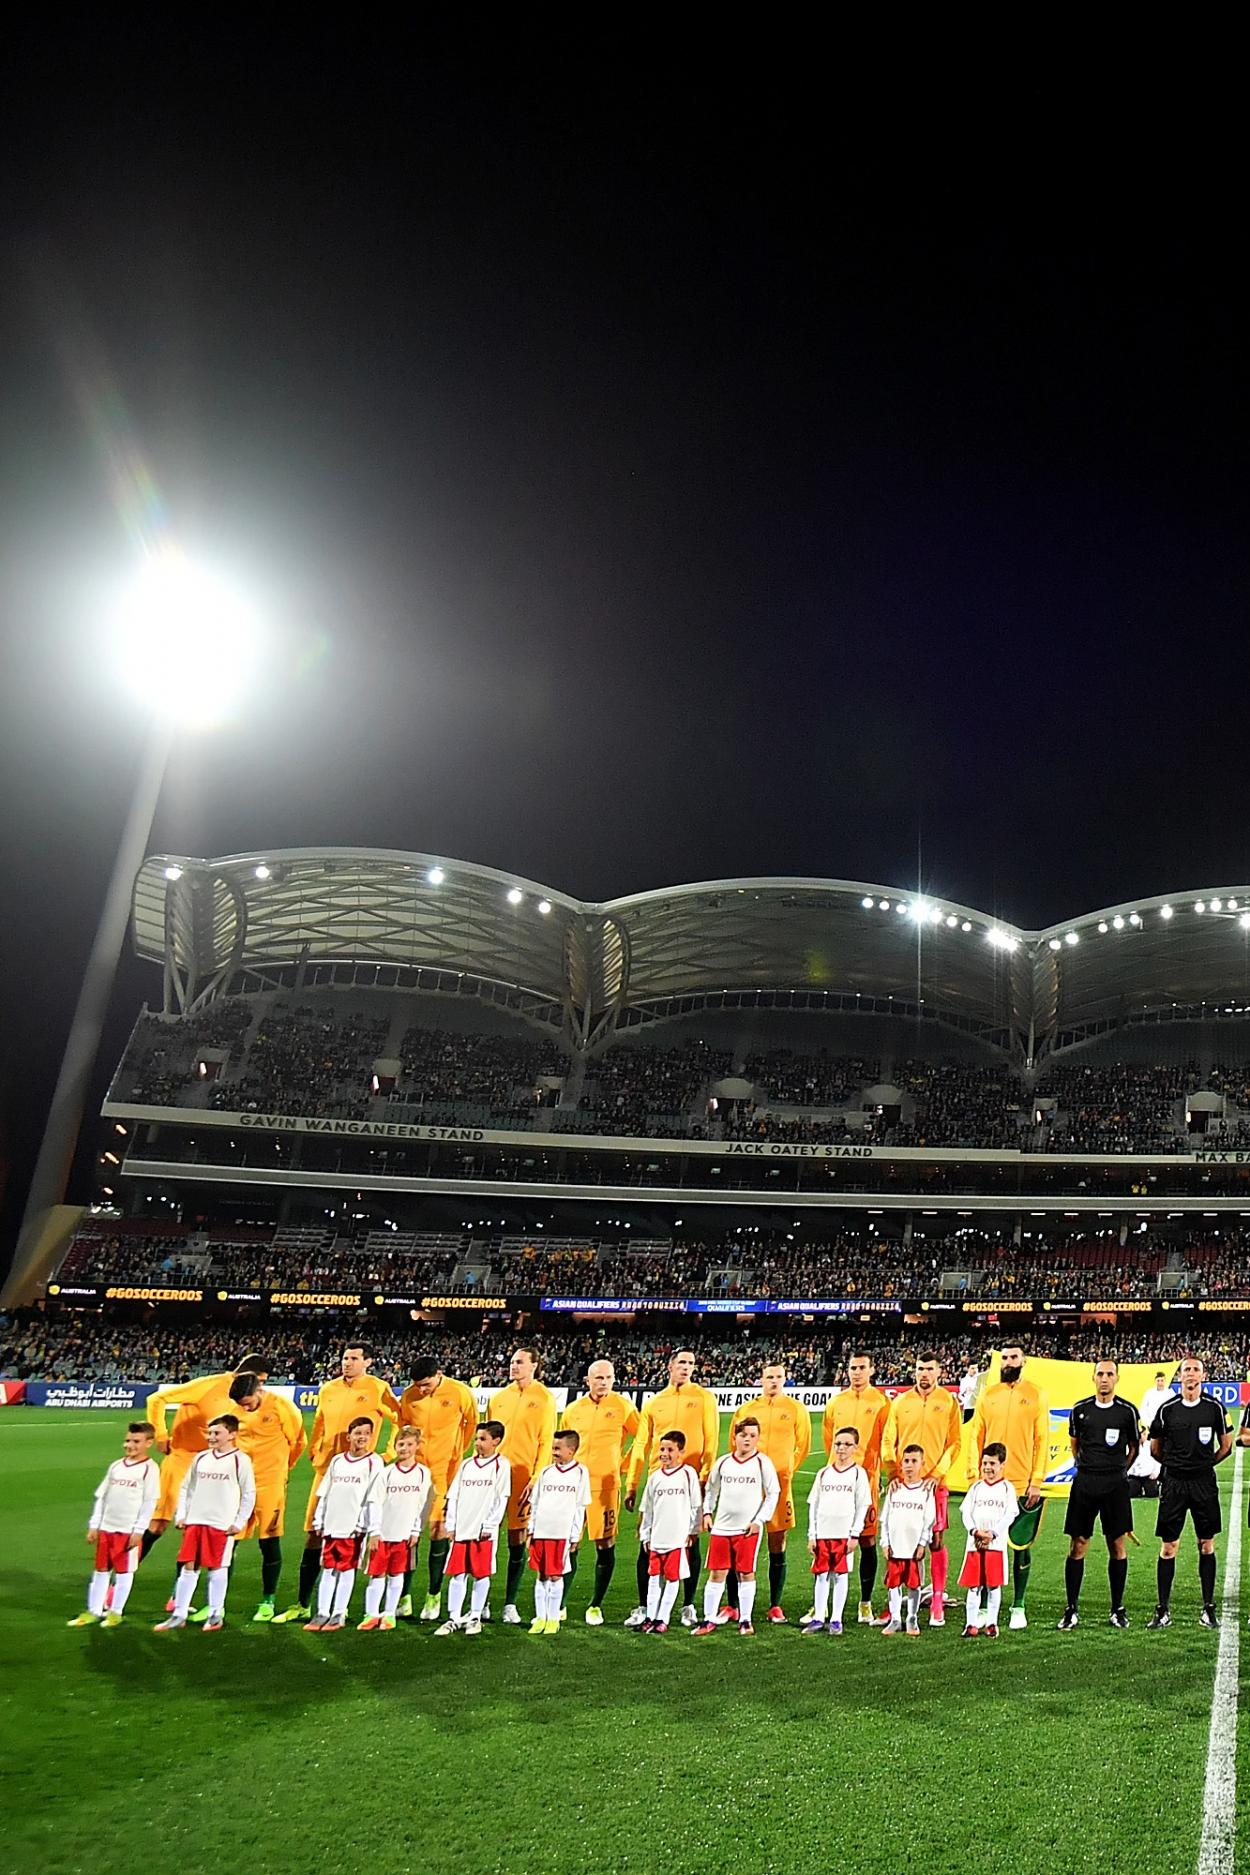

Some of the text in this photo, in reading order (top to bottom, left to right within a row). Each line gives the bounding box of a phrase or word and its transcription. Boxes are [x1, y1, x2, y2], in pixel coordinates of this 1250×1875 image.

[239, 1114, 484, 1141] GAVIN WANGANEEN STAND
[725, 1143, 873, 1157] JACK OATEY STAND
[1195, 1152, 1228, 1163] MAX
[105, 1287, 203, 1301] #GOSOCCEROOS
[270, 1292, 360, 1306] #GOSOCCEROOS
[421, 1296, 507, 1309] #GOSOCCEROOS
[962, 1302, 1033, 1312] #GOSOCCEROOS
[1083, 1302, 1152, 1311] #GOSOCCEROOS
[64, 1399, 91, 1407] DHABI
[91, 1400, 133, 1408] AIRPORTS
[462, 1479, 493, 1487] TOYOTA
[723, 1476, 756, 1484] TOYOTA
[386, 1485, 420, 1493] TOYOTA
[543, 1484, 576, 1493] TOYOTA
[821, 1485, 853, 1493] TOYOTA
[892, 1501, 924, 1511] TOYOTA
[603, 1509, 616, 1527] 13
